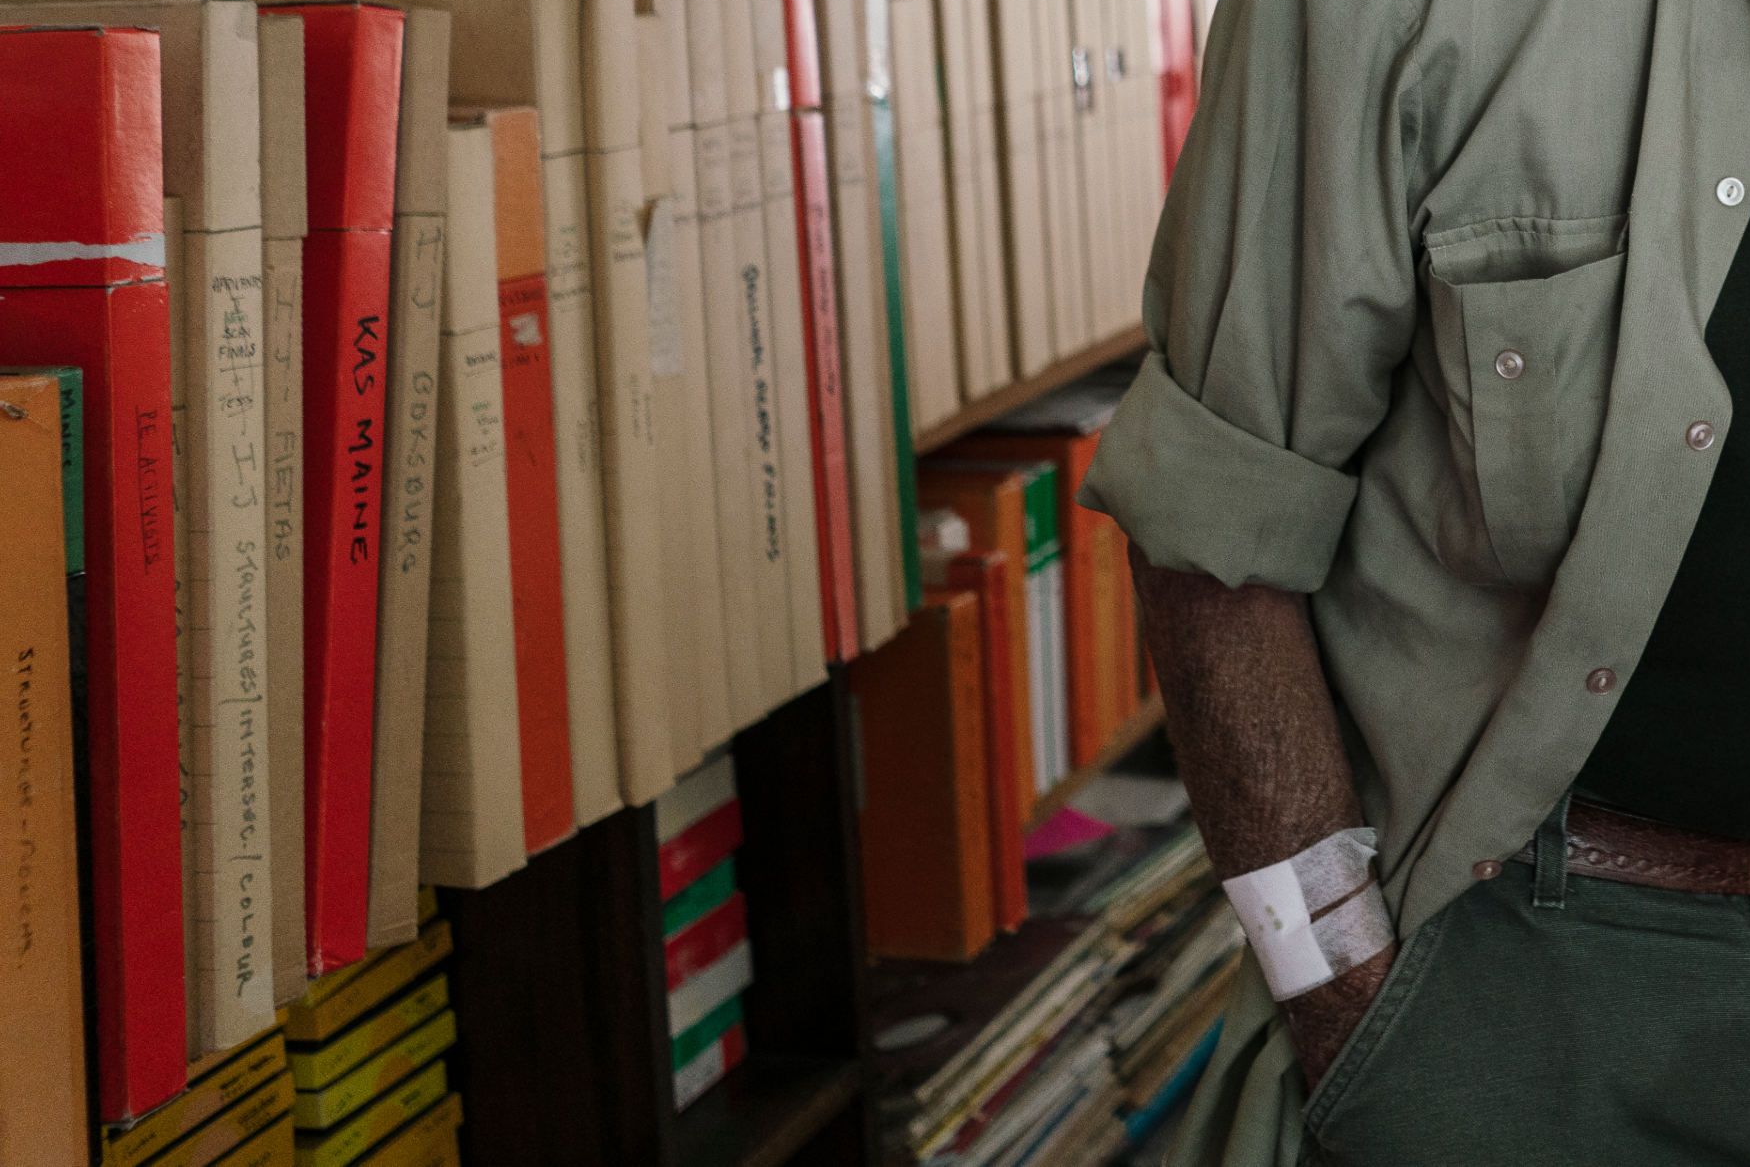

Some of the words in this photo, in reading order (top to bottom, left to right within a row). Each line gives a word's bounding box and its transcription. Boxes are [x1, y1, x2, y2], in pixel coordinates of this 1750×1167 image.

[353, 315, 380, 397] KAS
[138, 457, 162, 566] ACTIVISTS
[274, 430, 296, 562] FIETAS
[349, 418, 374, 566] MAINE
[398, 371, 435, 575] BOKSBURG
